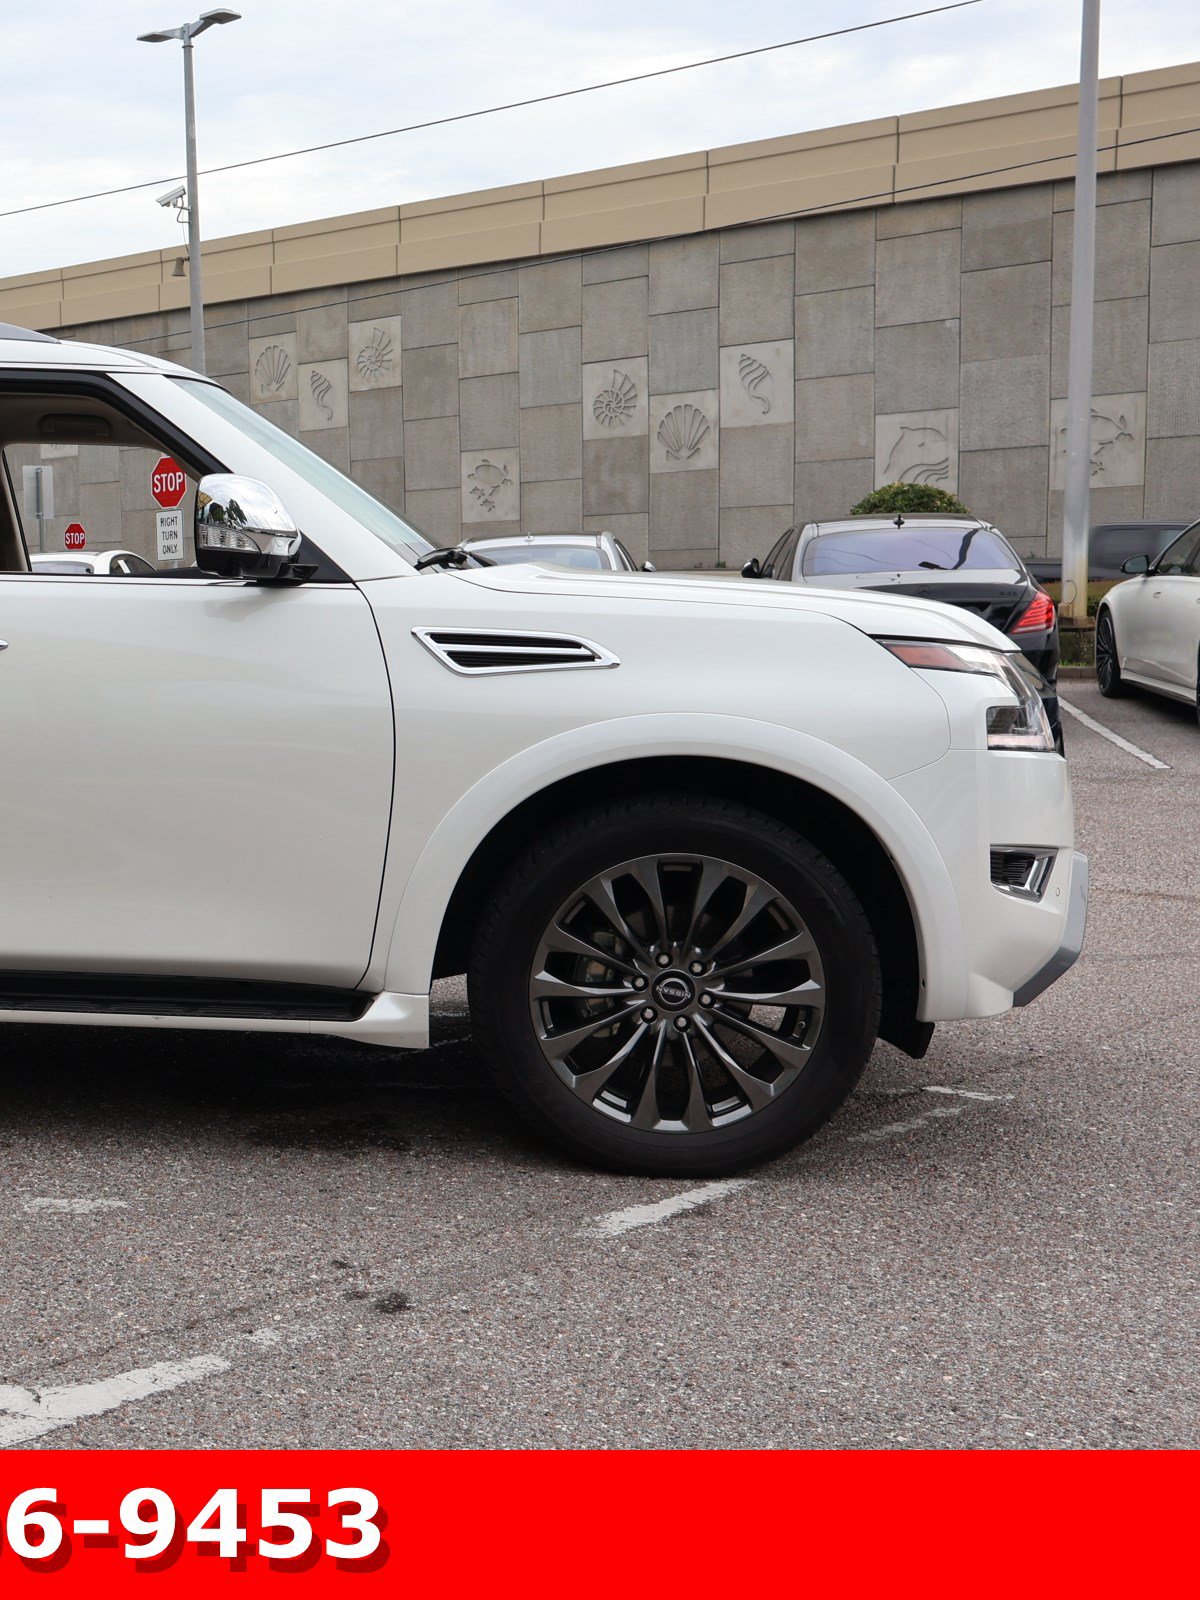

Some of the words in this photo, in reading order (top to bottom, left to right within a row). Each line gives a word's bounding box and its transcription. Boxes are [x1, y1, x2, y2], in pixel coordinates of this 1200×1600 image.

[153, 472, 184, 493] STOP
[160, 516, 178, 527] RIGHT
[65, 532, 85, 545] STOP
[161, 531, 178, 541] TURN
[162, 544, 178, 555] ONLY
[656, 985, 692, 999] NISSAN
